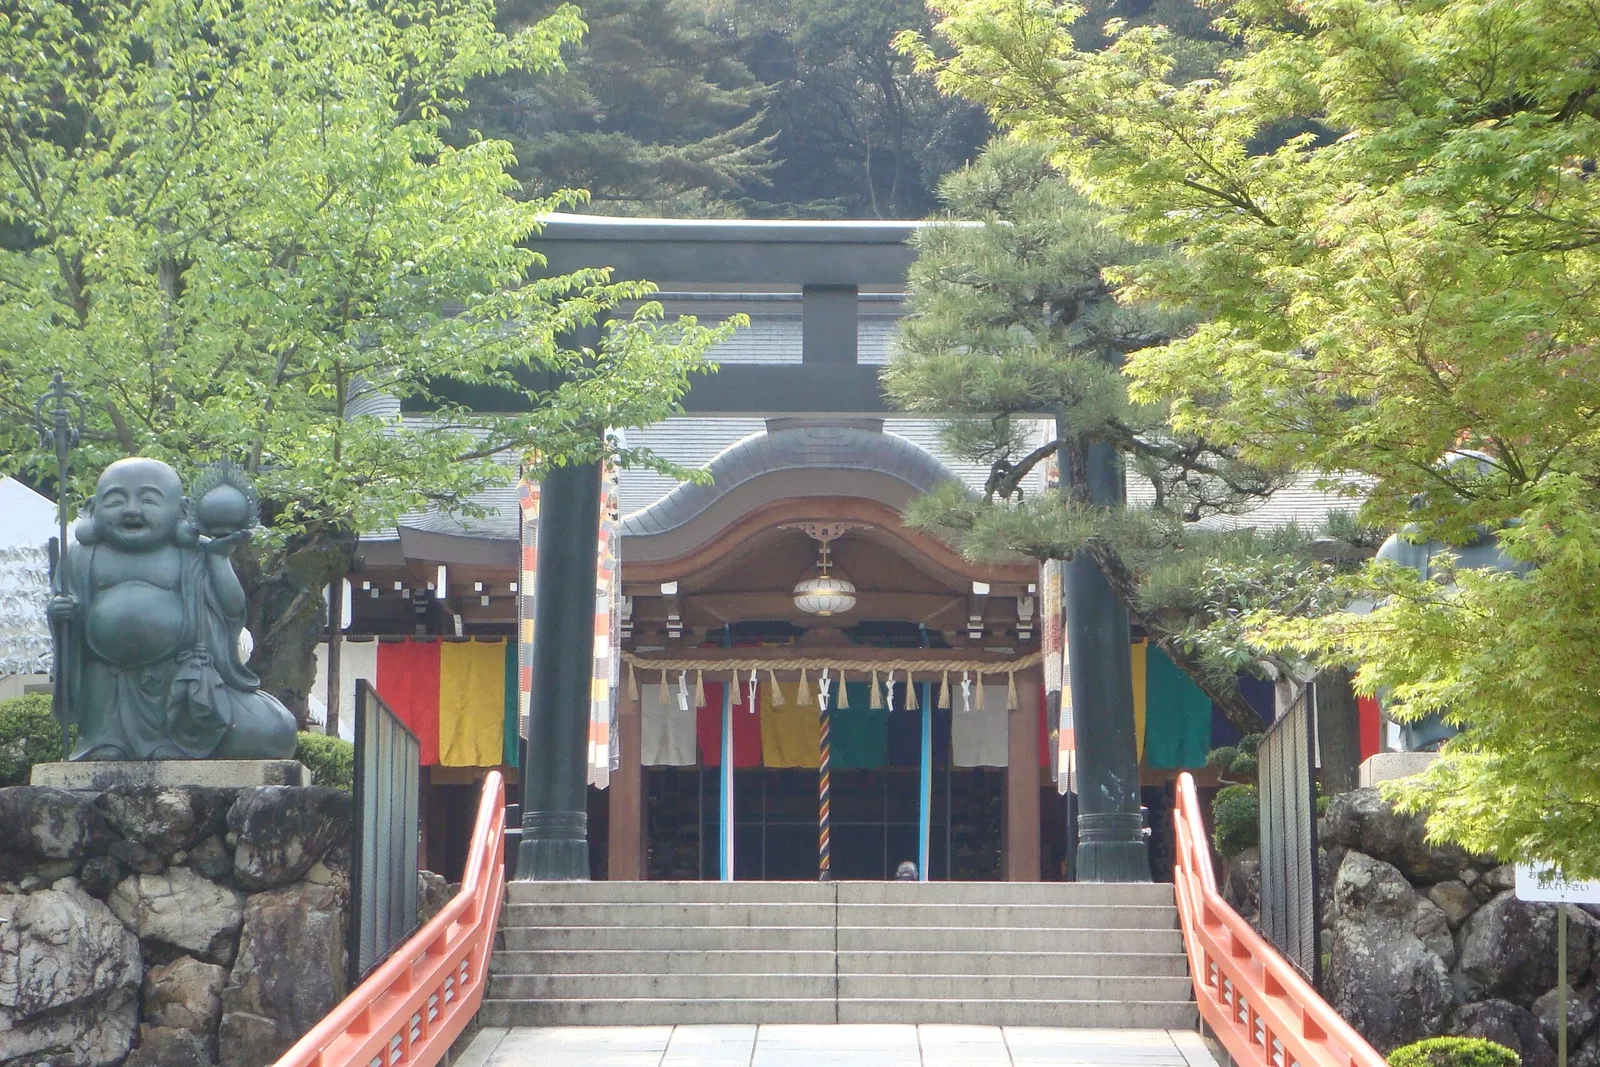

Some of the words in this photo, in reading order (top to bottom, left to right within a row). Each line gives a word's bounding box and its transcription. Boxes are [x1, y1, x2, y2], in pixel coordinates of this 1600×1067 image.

[1536, 882, 1590, 892] お入れ下さい
